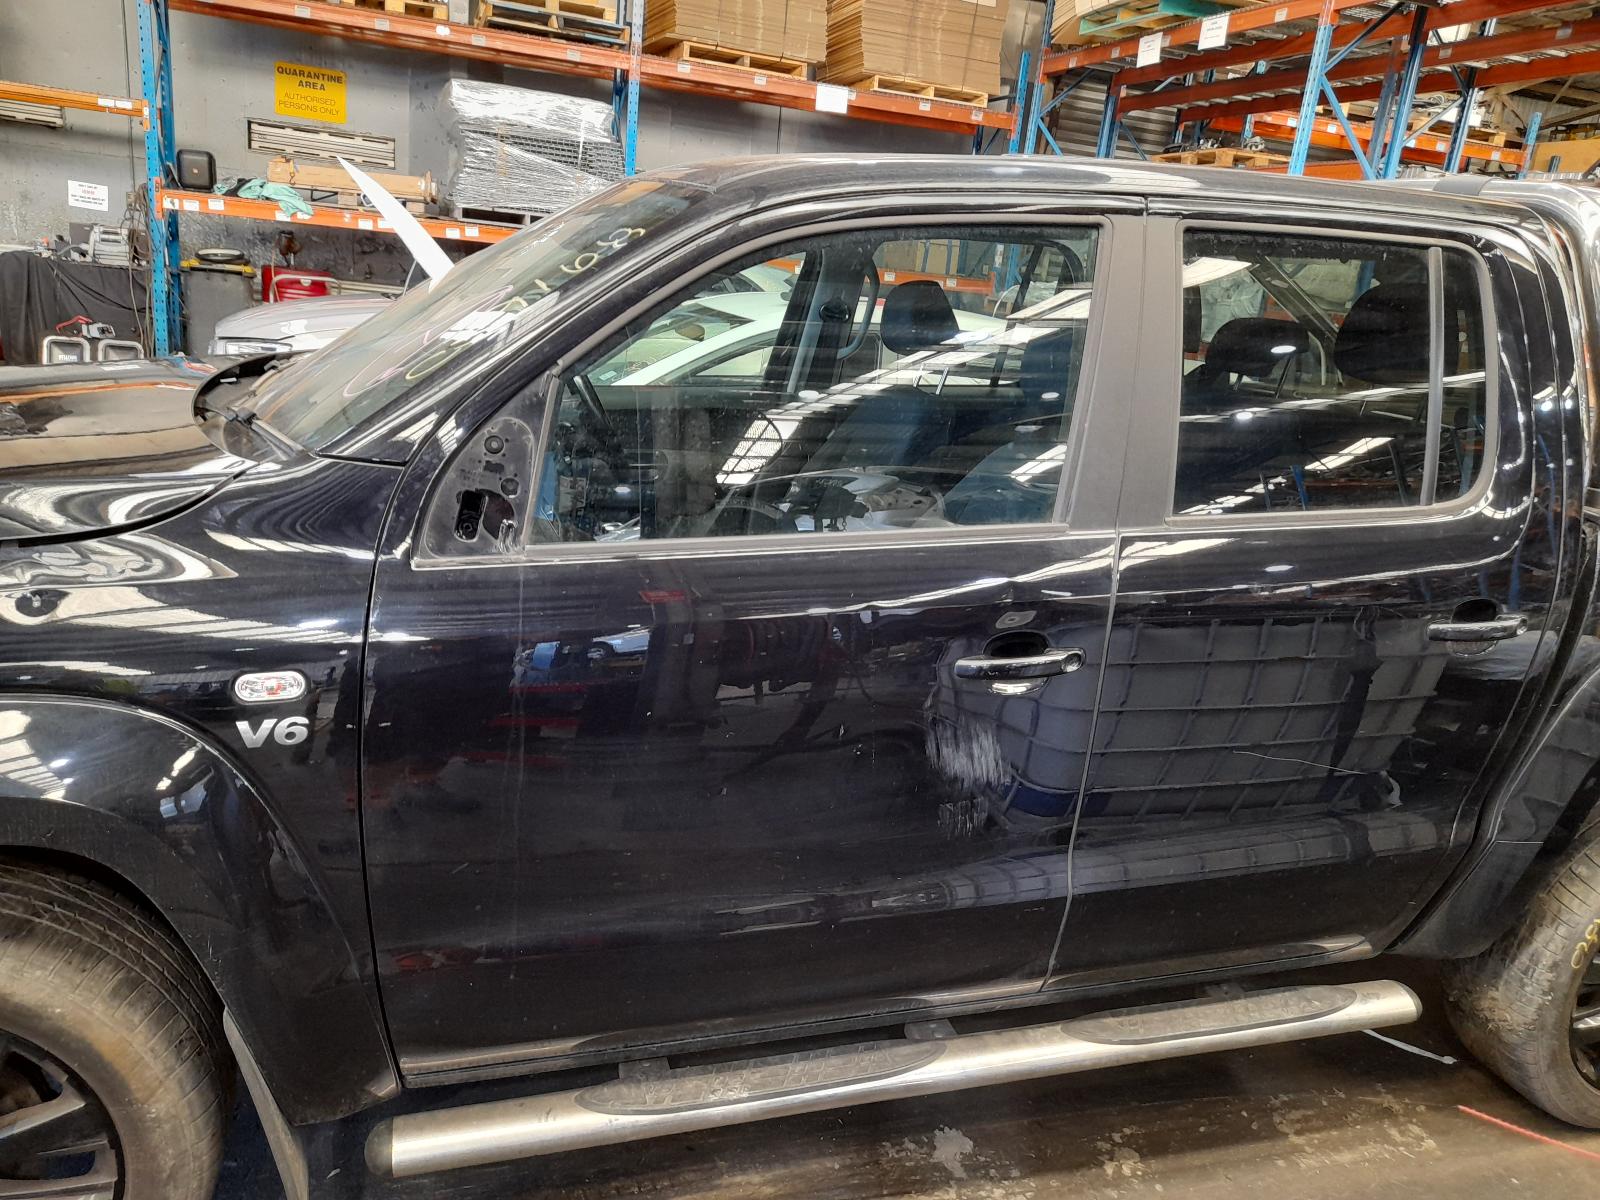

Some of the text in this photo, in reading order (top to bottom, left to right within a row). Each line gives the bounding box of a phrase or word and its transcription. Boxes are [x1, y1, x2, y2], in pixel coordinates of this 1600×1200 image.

[276, 65, 343, 84] QUARANTINE
[298, 80, 325, 91] AREA
[285, 91, 336, 106] AUTHORISED
[279, 100, 340, 116] PERSONS ONLY
[236, 716, 309, 749] V6
